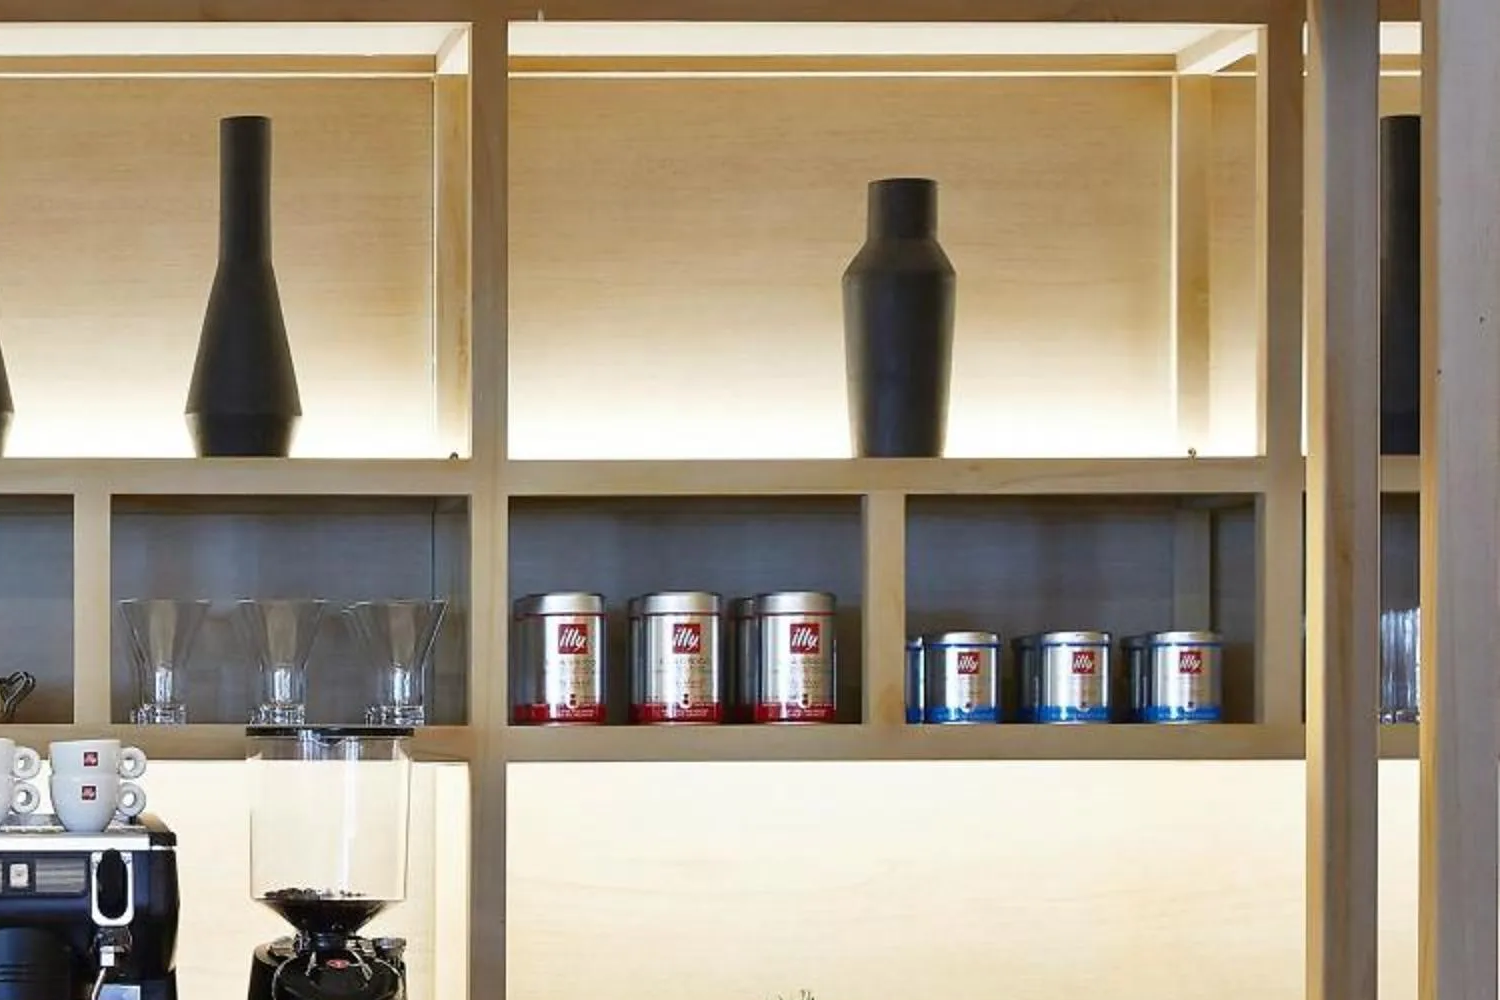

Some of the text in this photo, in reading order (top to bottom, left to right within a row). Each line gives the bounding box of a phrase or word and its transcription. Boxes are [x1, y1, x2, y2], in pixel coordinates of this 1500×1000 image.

[559, 628, 586, 652] illy
[671, 627, 700, 651] illy
[791, 627, 819, 651] illy
